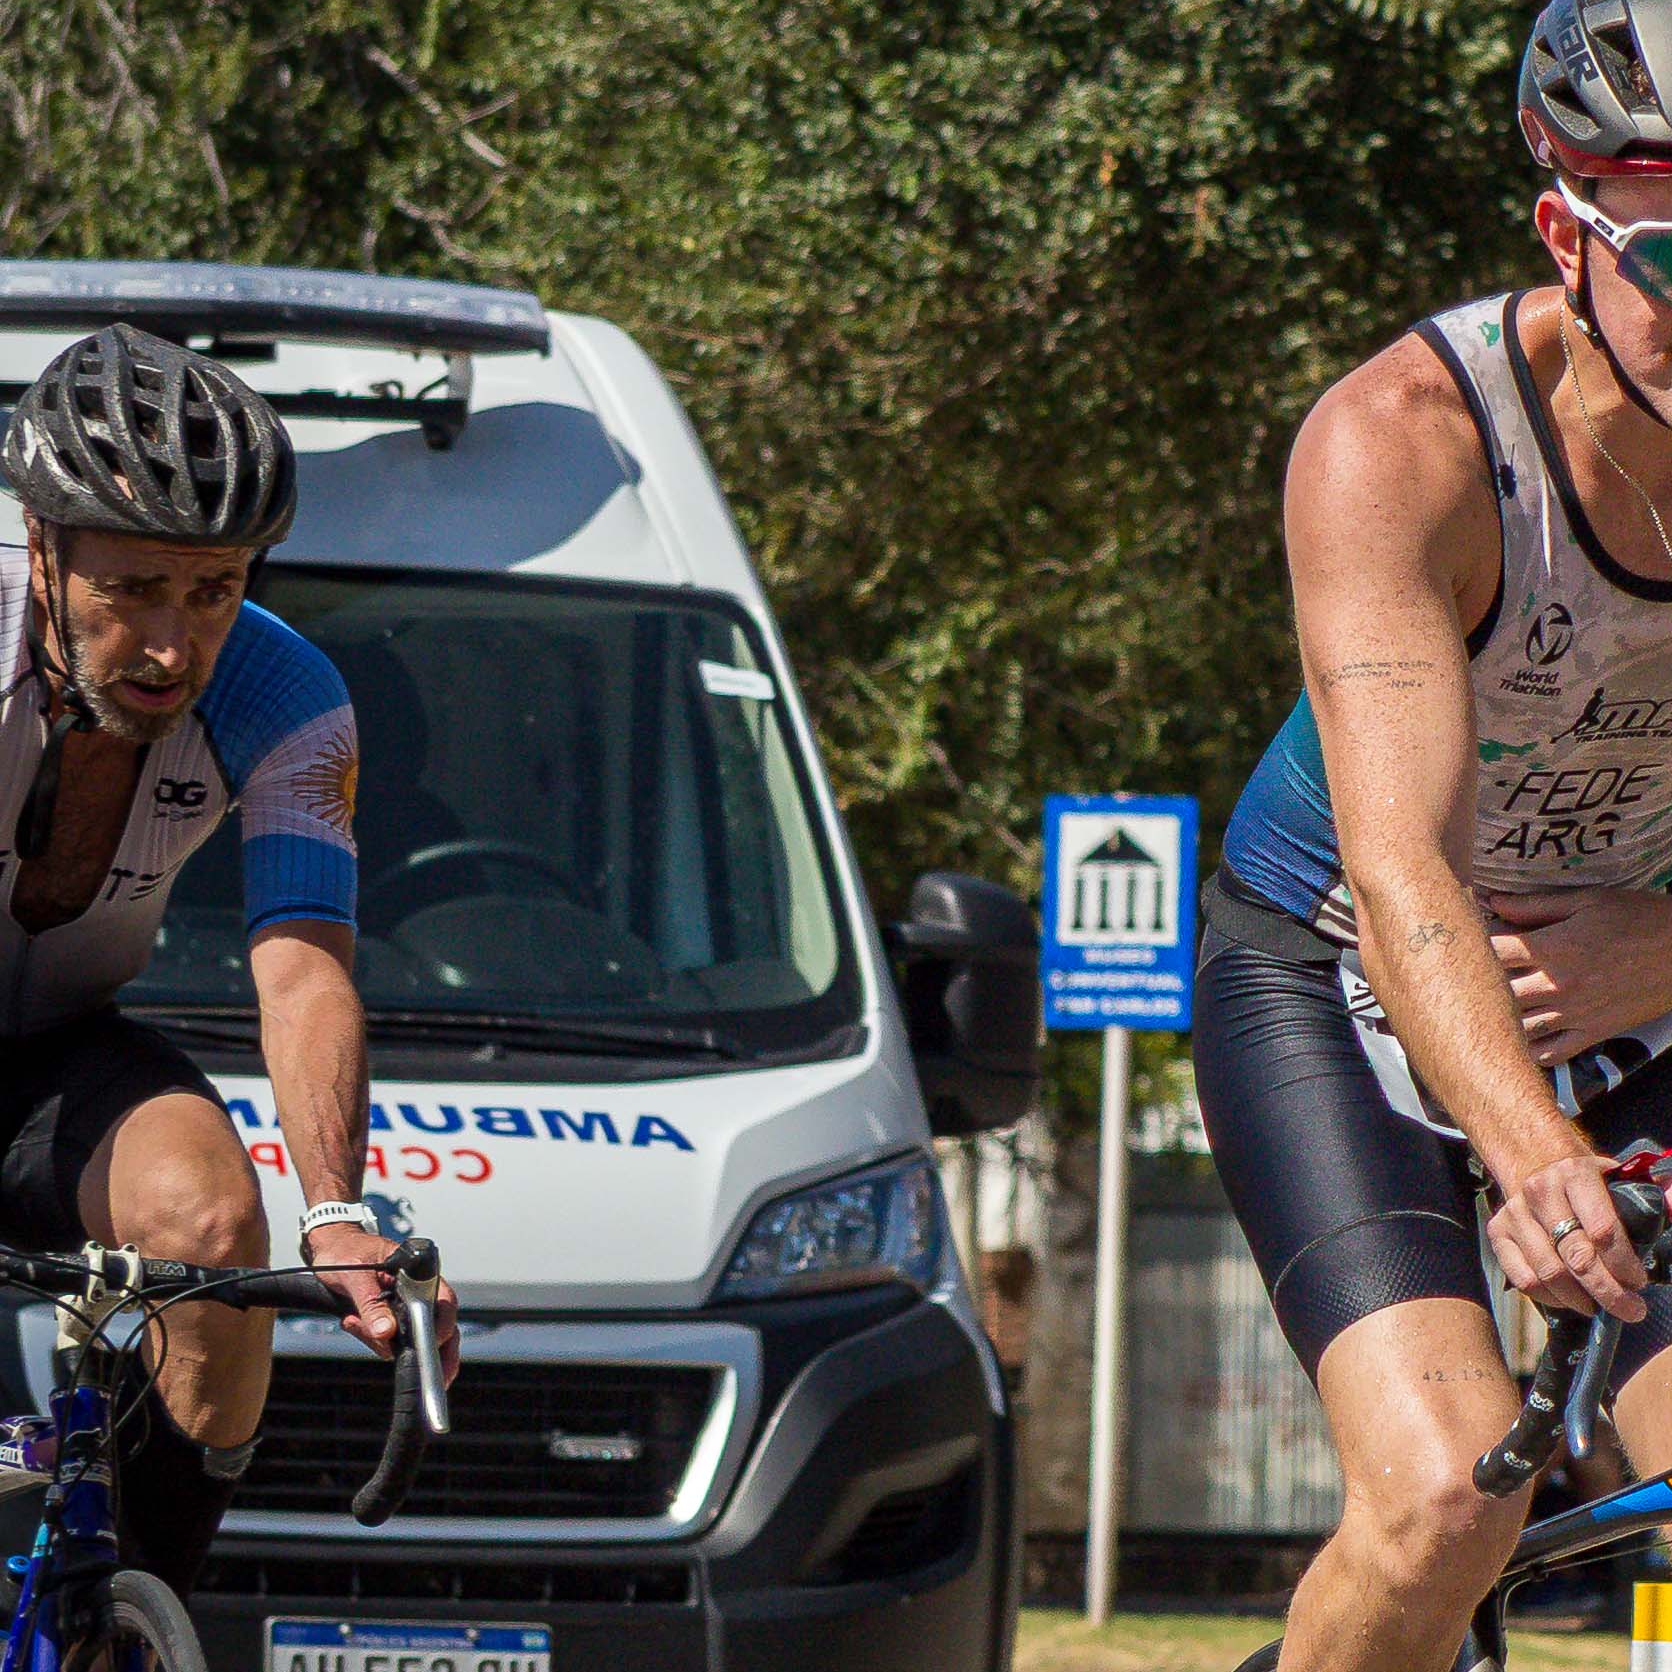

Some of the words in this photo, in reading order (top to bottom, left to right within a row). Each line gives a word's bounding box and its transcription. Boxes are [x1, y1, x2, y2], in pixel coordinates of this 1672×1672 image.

[1515, 670, 1560, 685] World
[1499, 678, 1562, 697] Triathlon
[1576, 729, 1649, 744] TRAINING
[1502, 763, 1664, 817] FEDE
[1485, 812, 1622, 860] ARG
